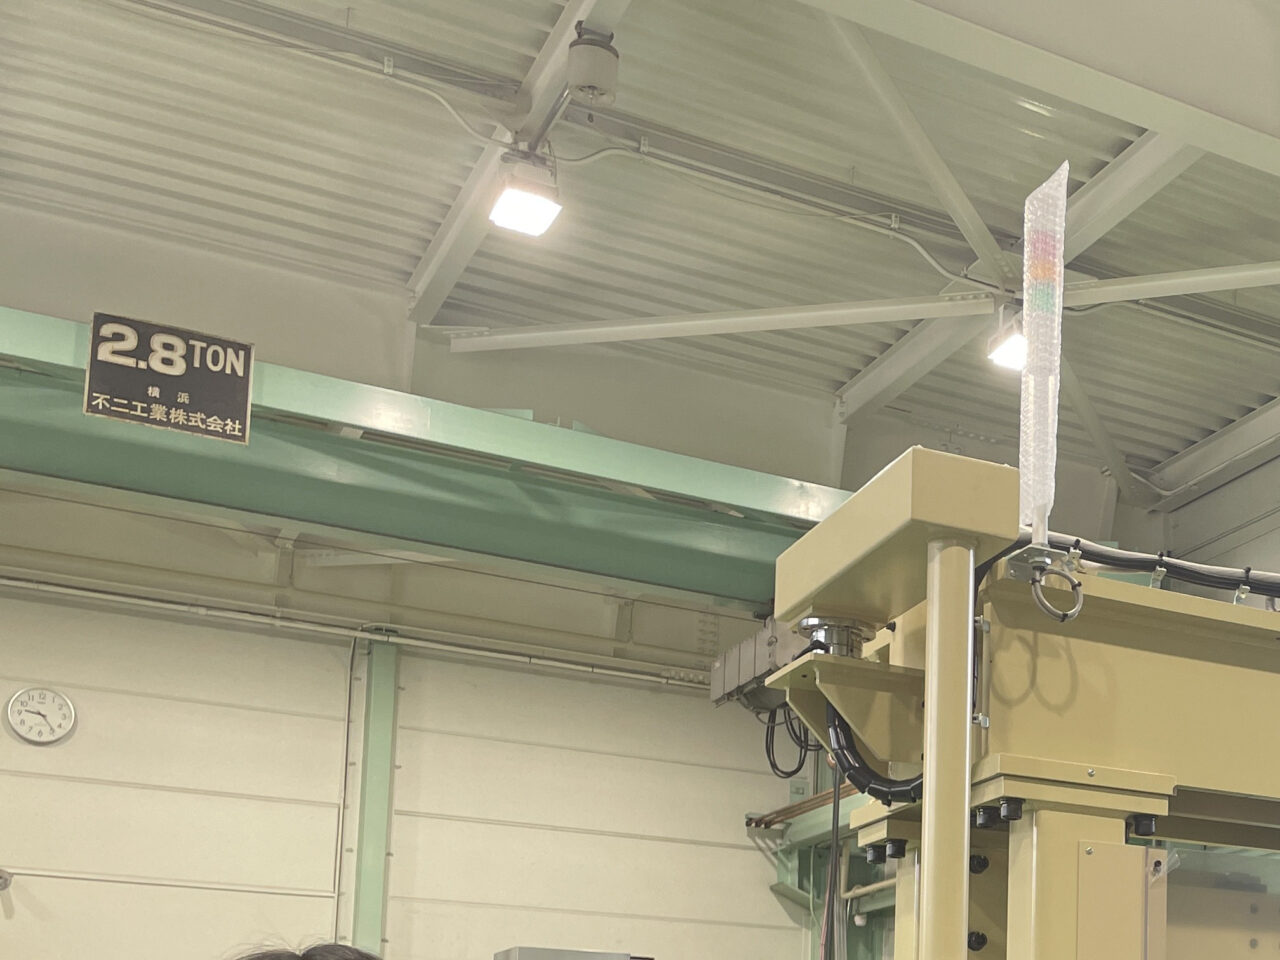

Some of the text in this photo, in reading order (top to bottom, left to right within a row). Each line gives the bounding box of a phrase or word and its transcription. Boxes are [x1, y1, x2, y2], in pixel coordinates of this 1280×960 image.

[97, 322, 246, 377] 2.8 TON
[91, 392, 243, 437] 不二工業株式会社
